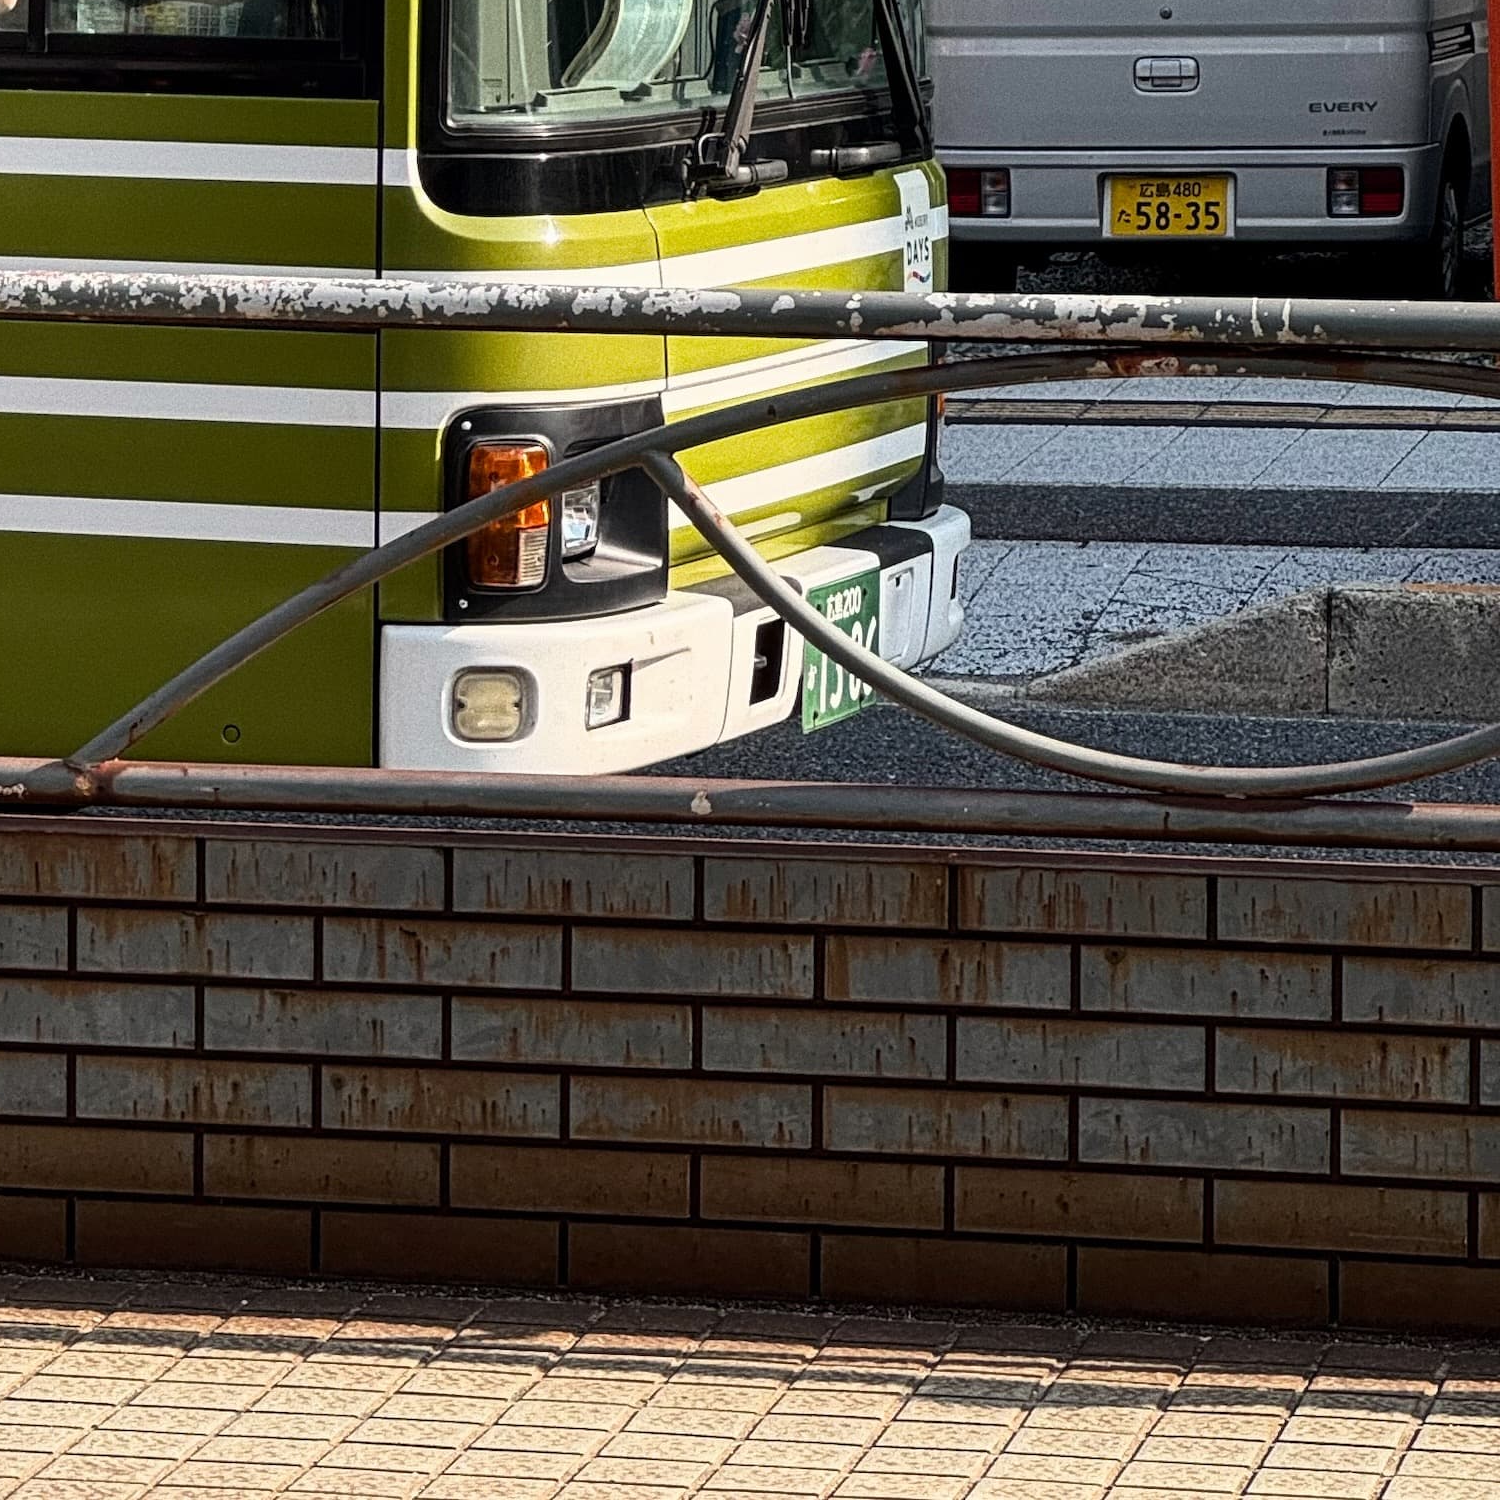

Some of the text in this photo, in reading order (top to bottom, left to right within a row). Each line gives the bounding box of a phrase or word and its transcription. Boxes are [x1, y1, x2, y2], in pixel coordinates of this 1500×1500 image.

[1308, 101, 1378, 113] EVERY
[1139, 181, 1202, 198] 広島480
[1117, 201, 1221, 231] た 58-35
[907, 236, 930, 266] DAYS
